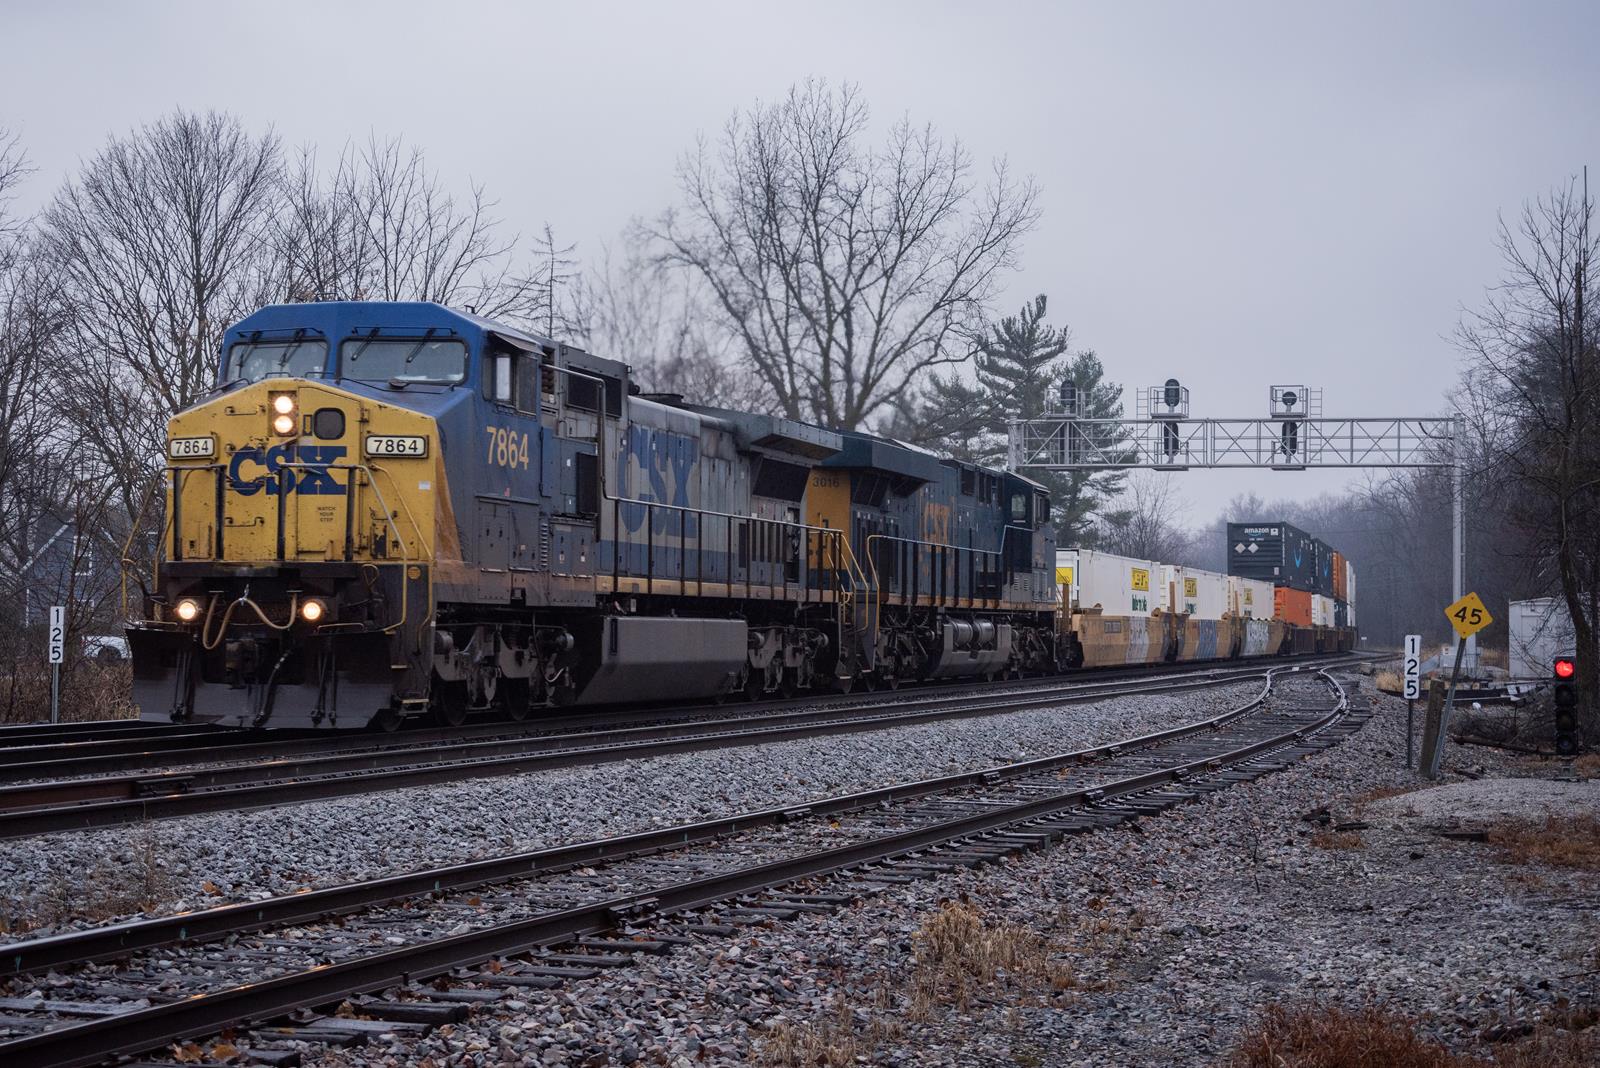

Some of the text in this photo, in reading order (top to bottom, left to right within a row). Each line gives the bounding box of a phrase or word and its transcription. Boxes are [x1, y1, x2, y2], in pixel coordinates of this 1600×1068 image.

[176, 440, 209, 455] 7864
[373, 439, 419, 453] 7864
[486, 426, 529, 471] 7864
[230, 445, 347, 496] CSX
[618, 424, 698, 538] CSX
[813, 477, 839, 487] 3016
[1244, 527, 1269, 535] amazon
[1454, 606, 1483, 625] 45
[52, 608, 62, 660] 125
[1406, 638, 1418, 696] 125
